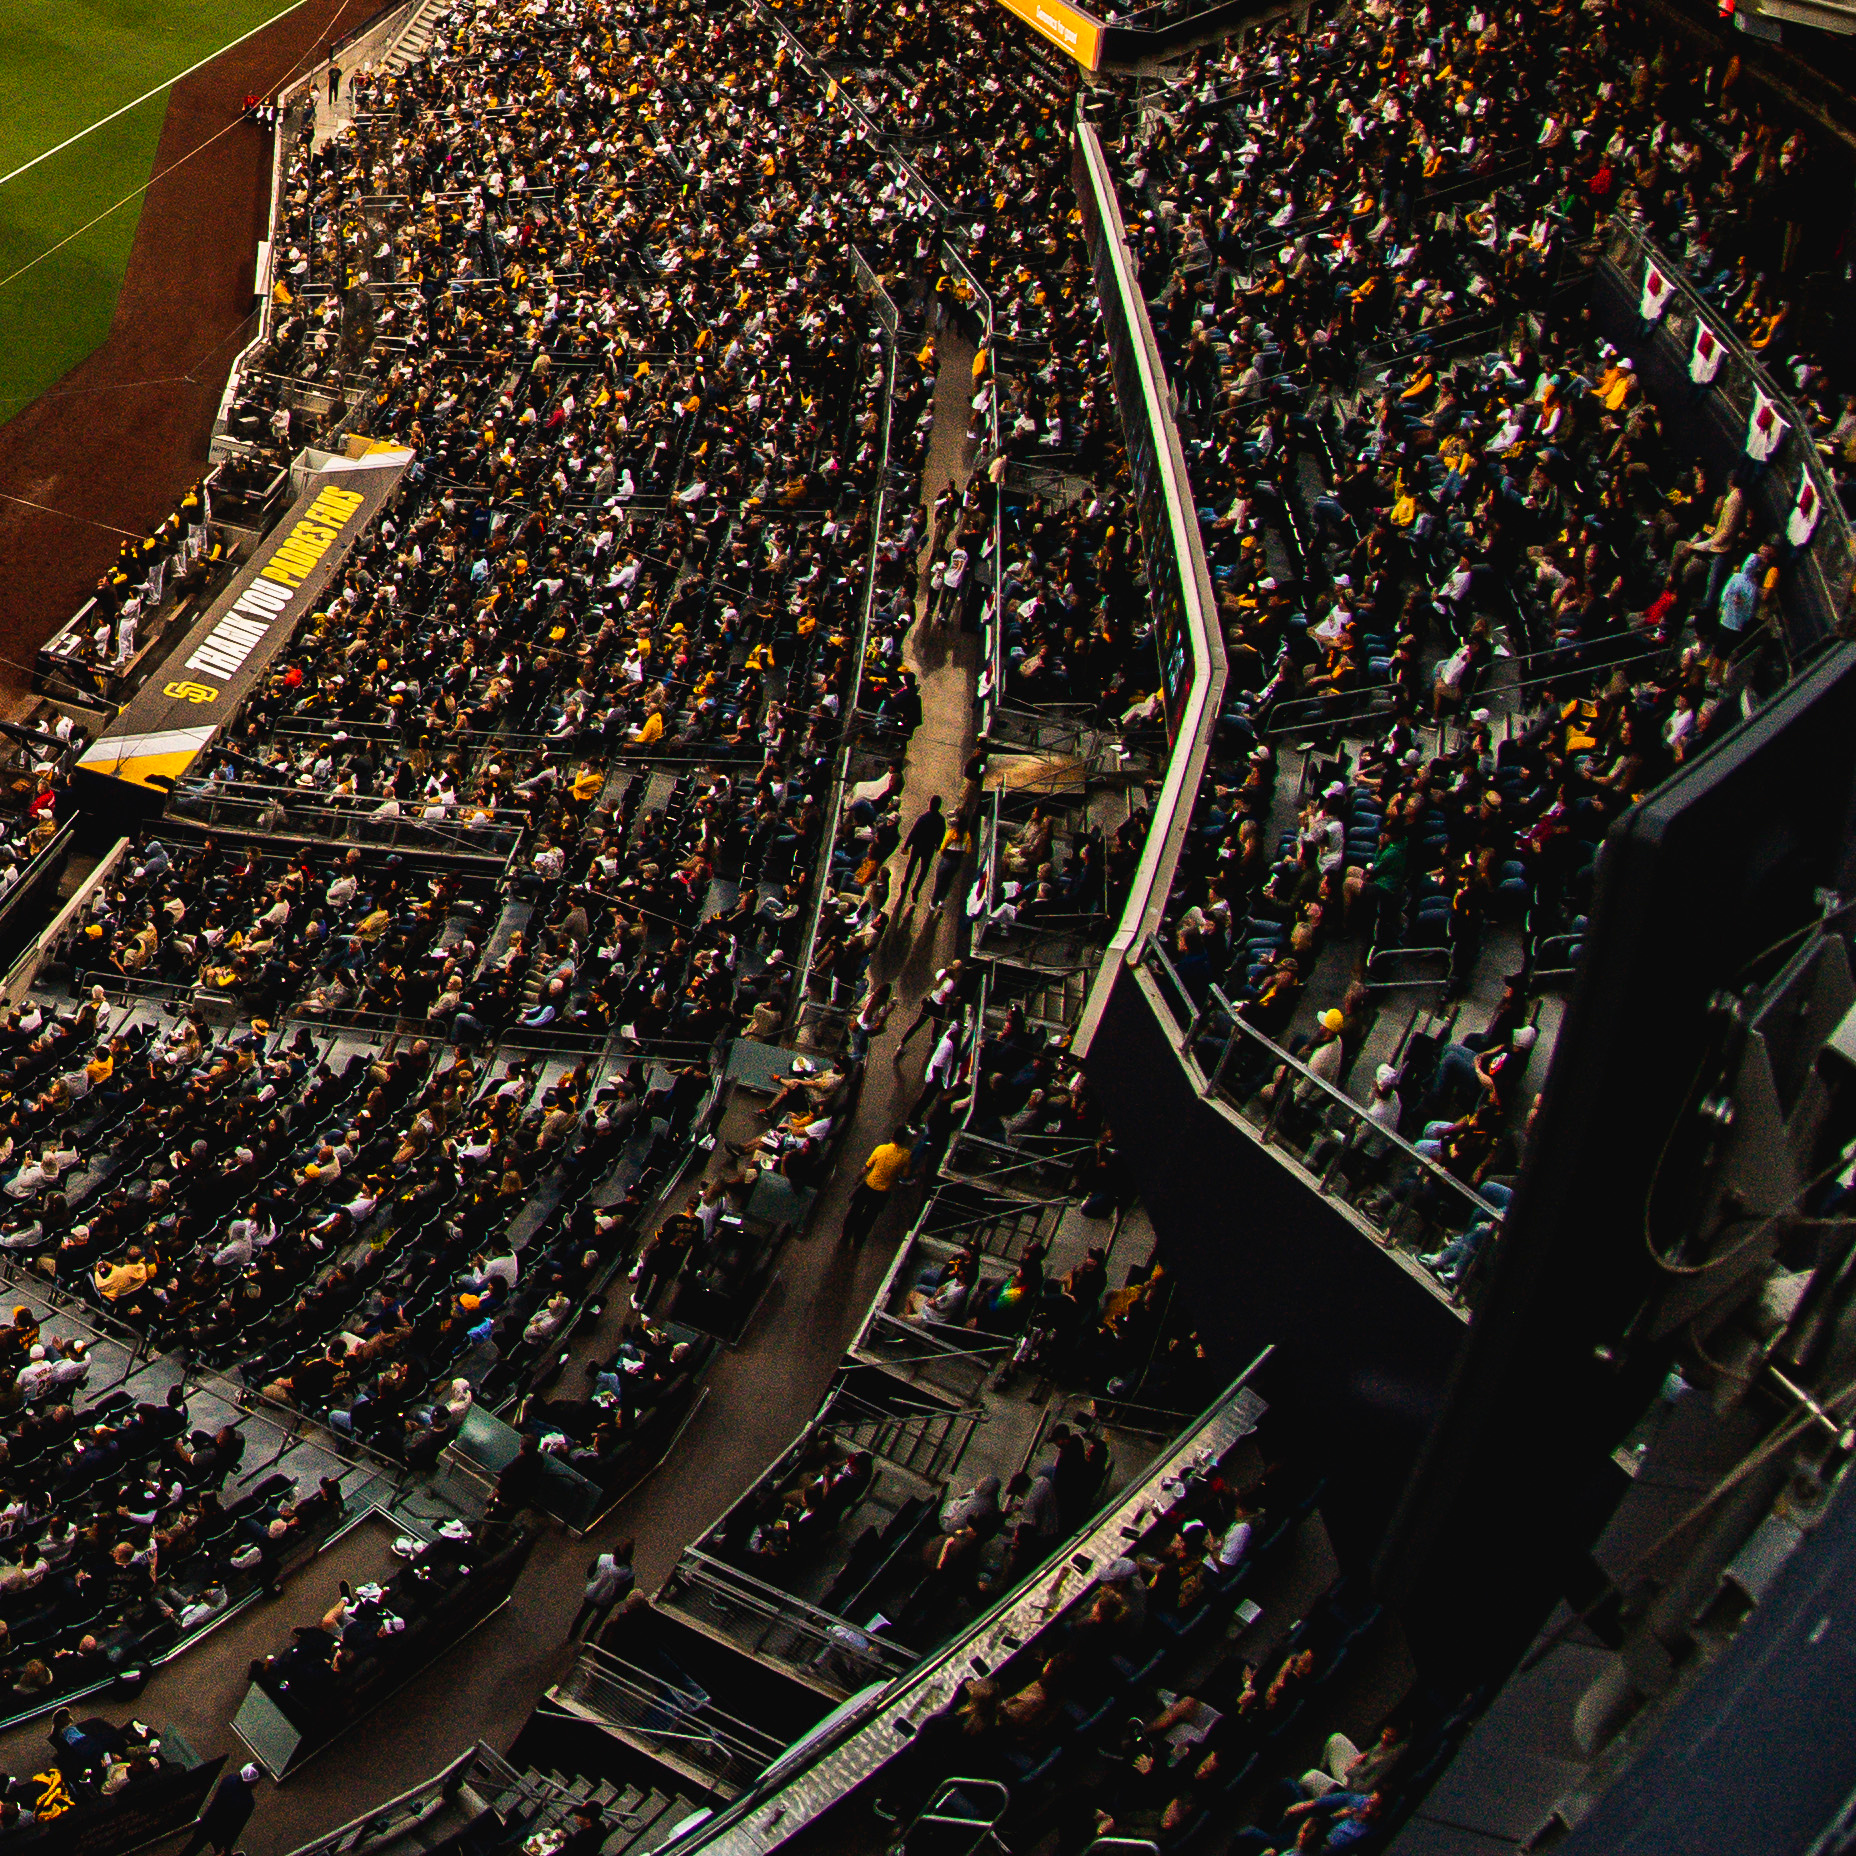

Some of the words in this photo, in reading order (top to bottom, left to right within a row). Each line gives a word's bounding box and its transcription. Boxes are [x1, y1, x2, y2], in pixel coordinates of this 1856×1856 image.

[304, 485, 365, 530] FANS
[260, 520, 338, 588] PADRES
[233, 578, 294, 621] YOU
[185, 610, 270, 681] THANK
